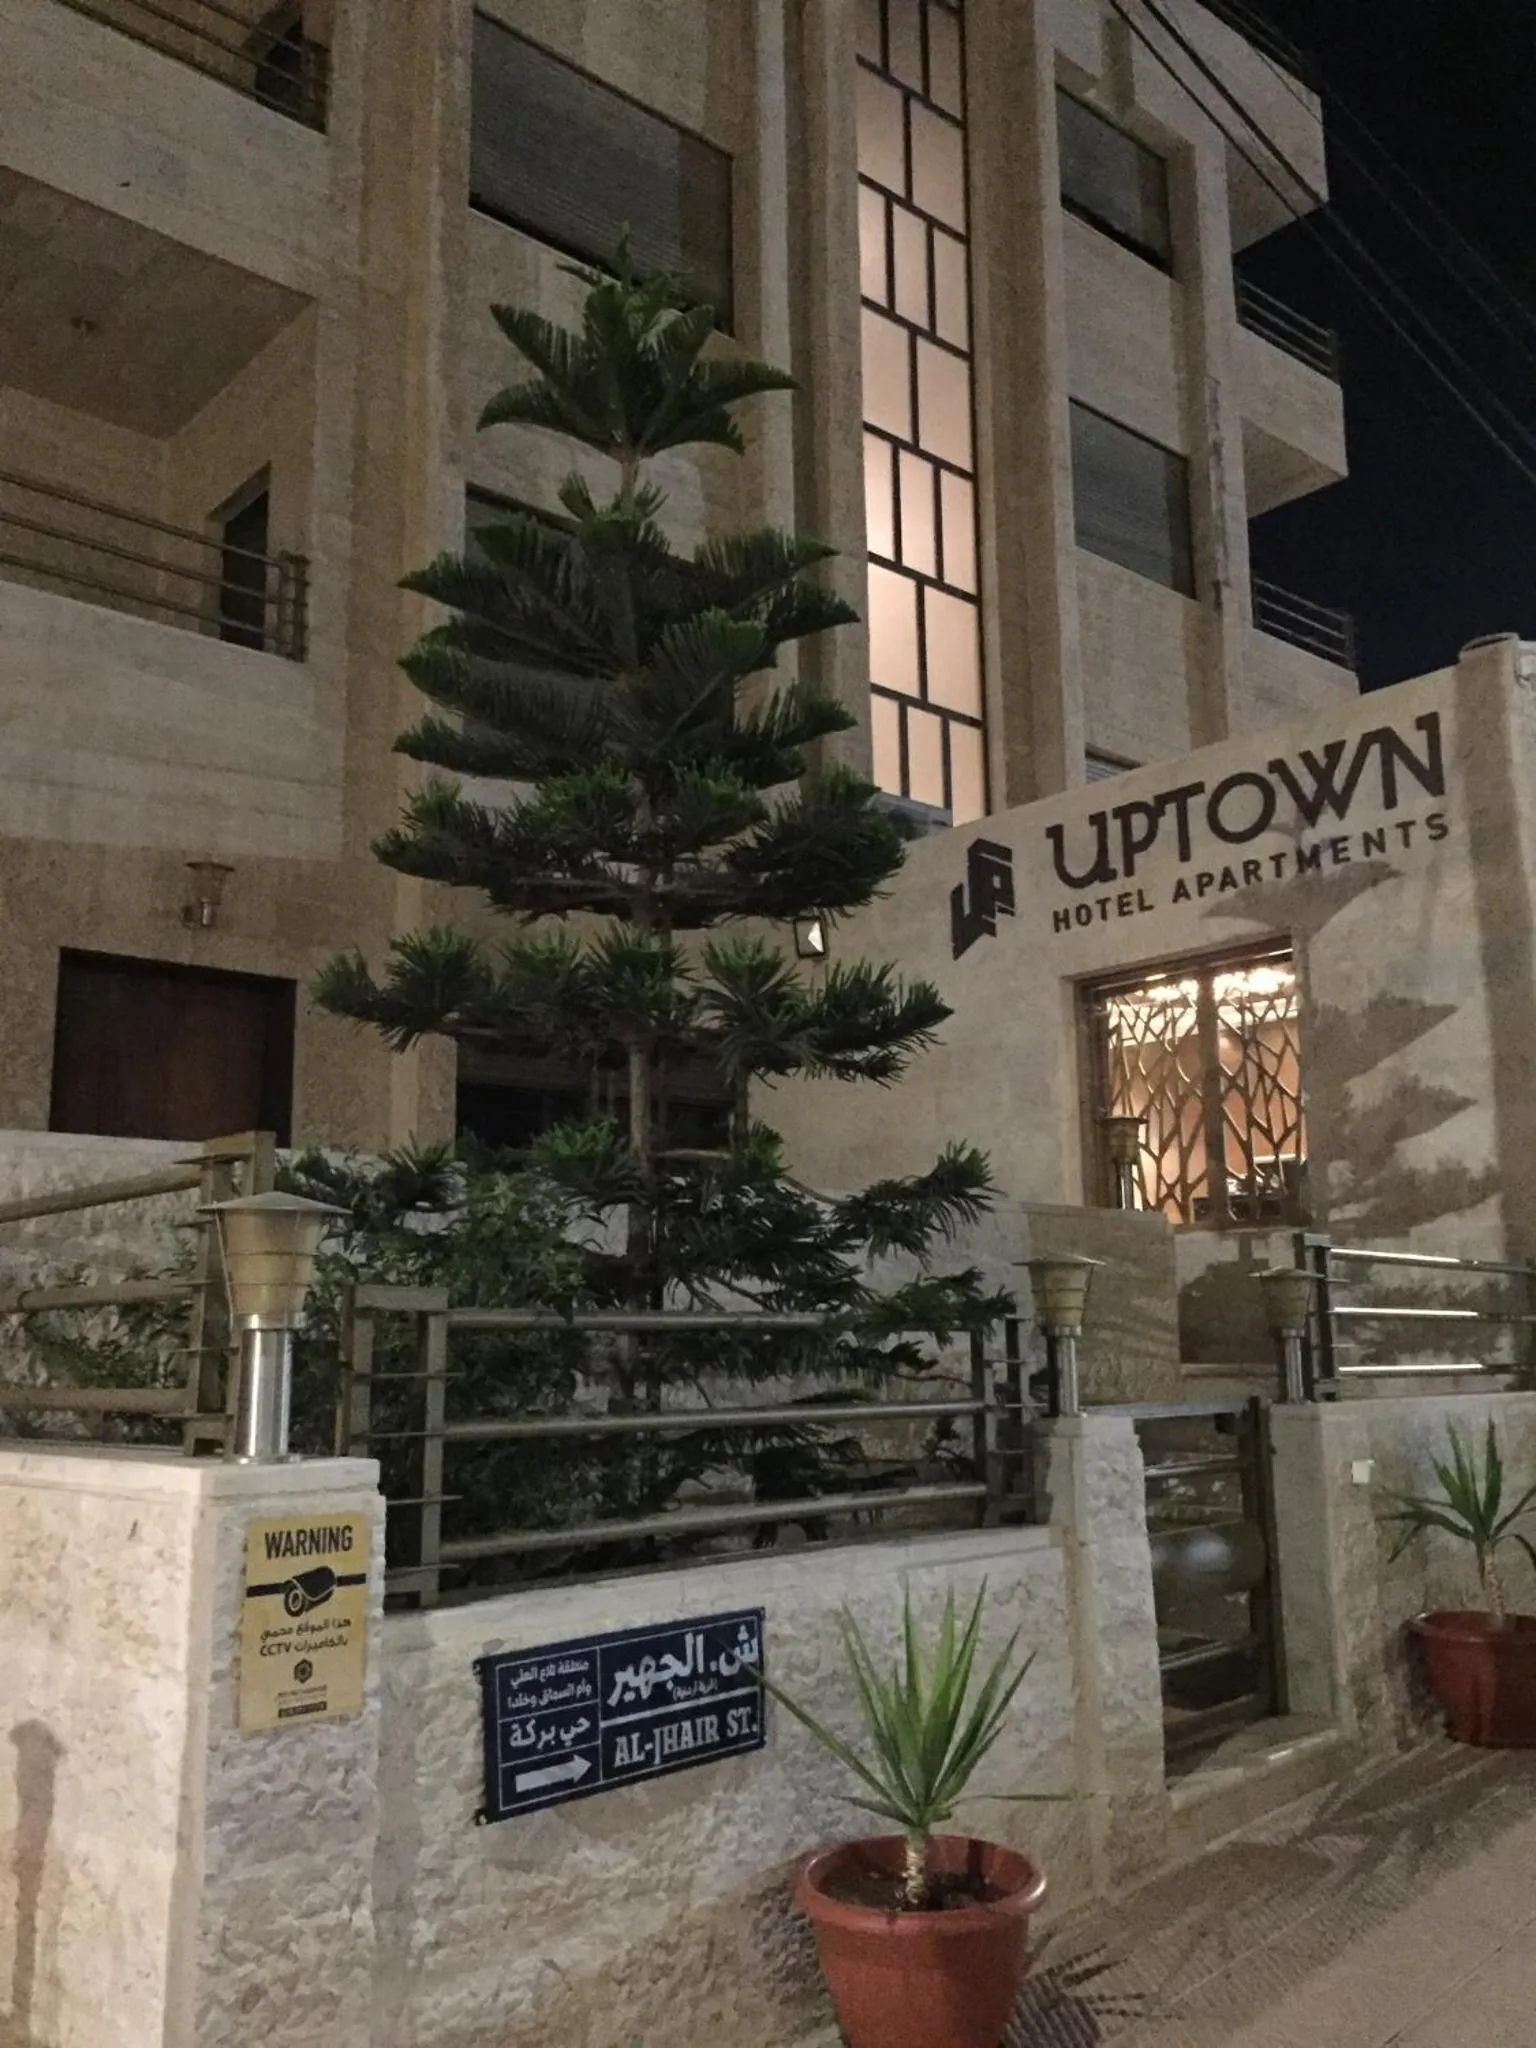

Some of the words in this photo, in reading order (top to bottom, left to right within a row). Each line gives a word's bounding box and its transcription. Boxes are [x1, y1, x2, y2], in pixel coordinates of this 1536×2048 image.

[1046, 711, 1445, 889] UPTOWN
[1053, 888, 1155, 932] HOTEL
[1172, 812, 1450, 904] APARTMENTS
[264, 1525, 353, 1560] WARNING
[260, 1642, 292, 1656] CCTV
[558, 1660, 589, 1675] منطقة
[606, 1632, 704, 1707] الجهير
[509, 1719, 556, 1749] بركة
[560, 1717, 590, 1748] حي
[614, 1714, 720, 1768] AL-JHAIR
[726, 1706, 758, 1737] ST.
